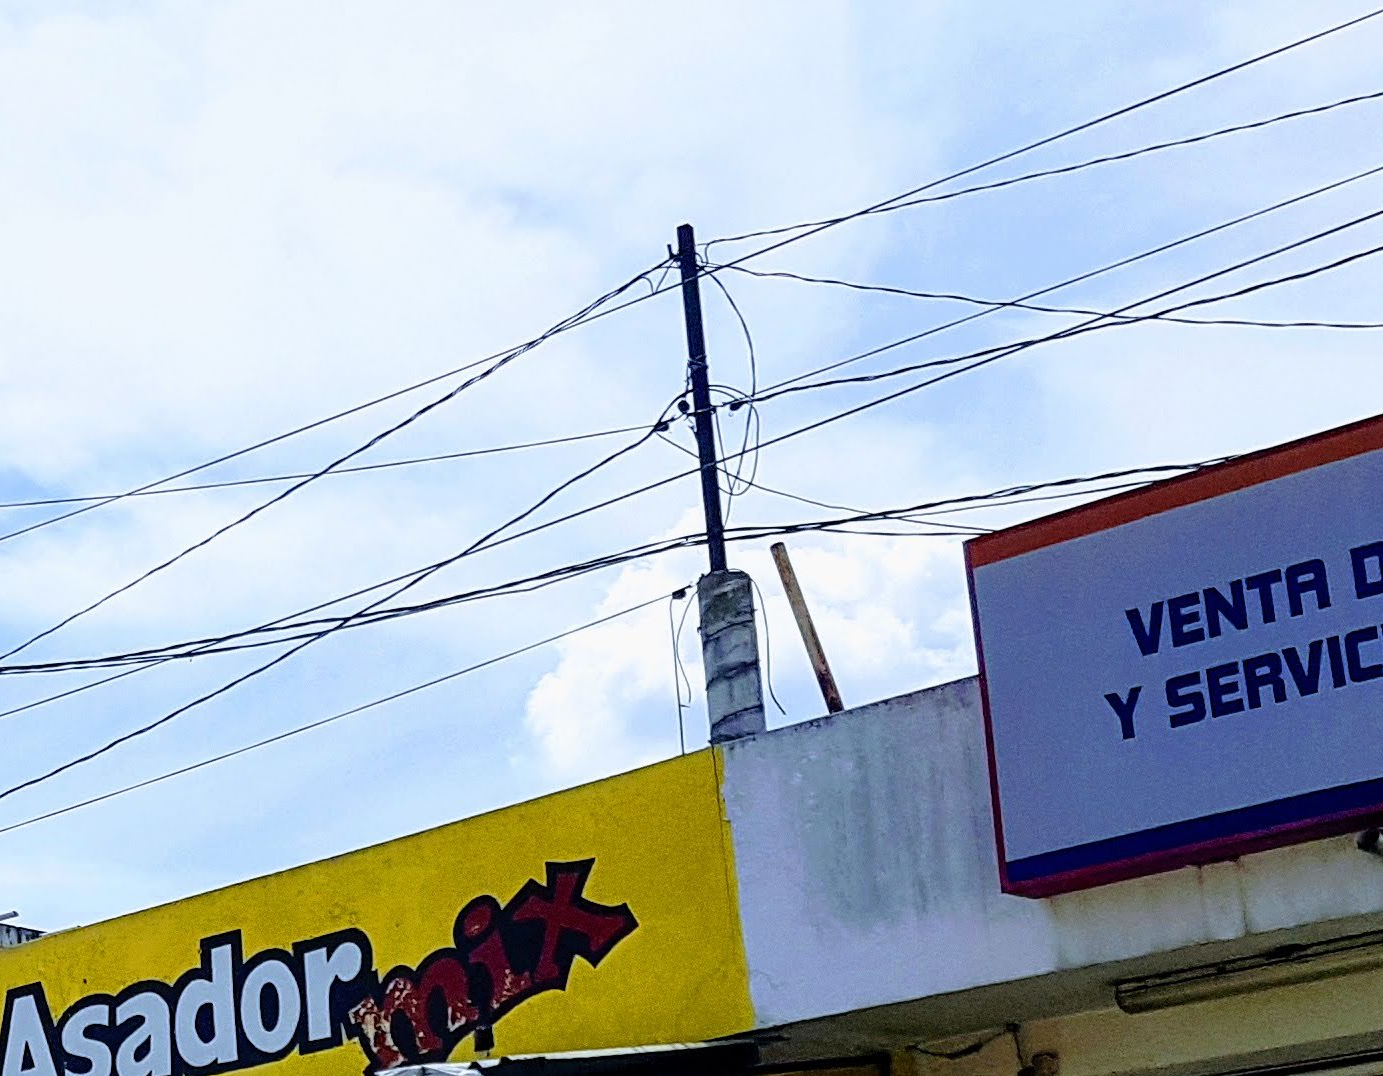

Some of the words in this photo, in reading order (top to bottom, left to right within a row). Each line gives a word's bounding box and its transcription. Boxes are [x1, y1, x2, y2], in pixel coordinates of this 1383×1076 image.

[1125, 558, 1331, 656] VENTA
[1104, 685, 1142, 740] Y
[1165, 624, 1383, 729] SERVIC
[349, 870, 629, 1070] mix
